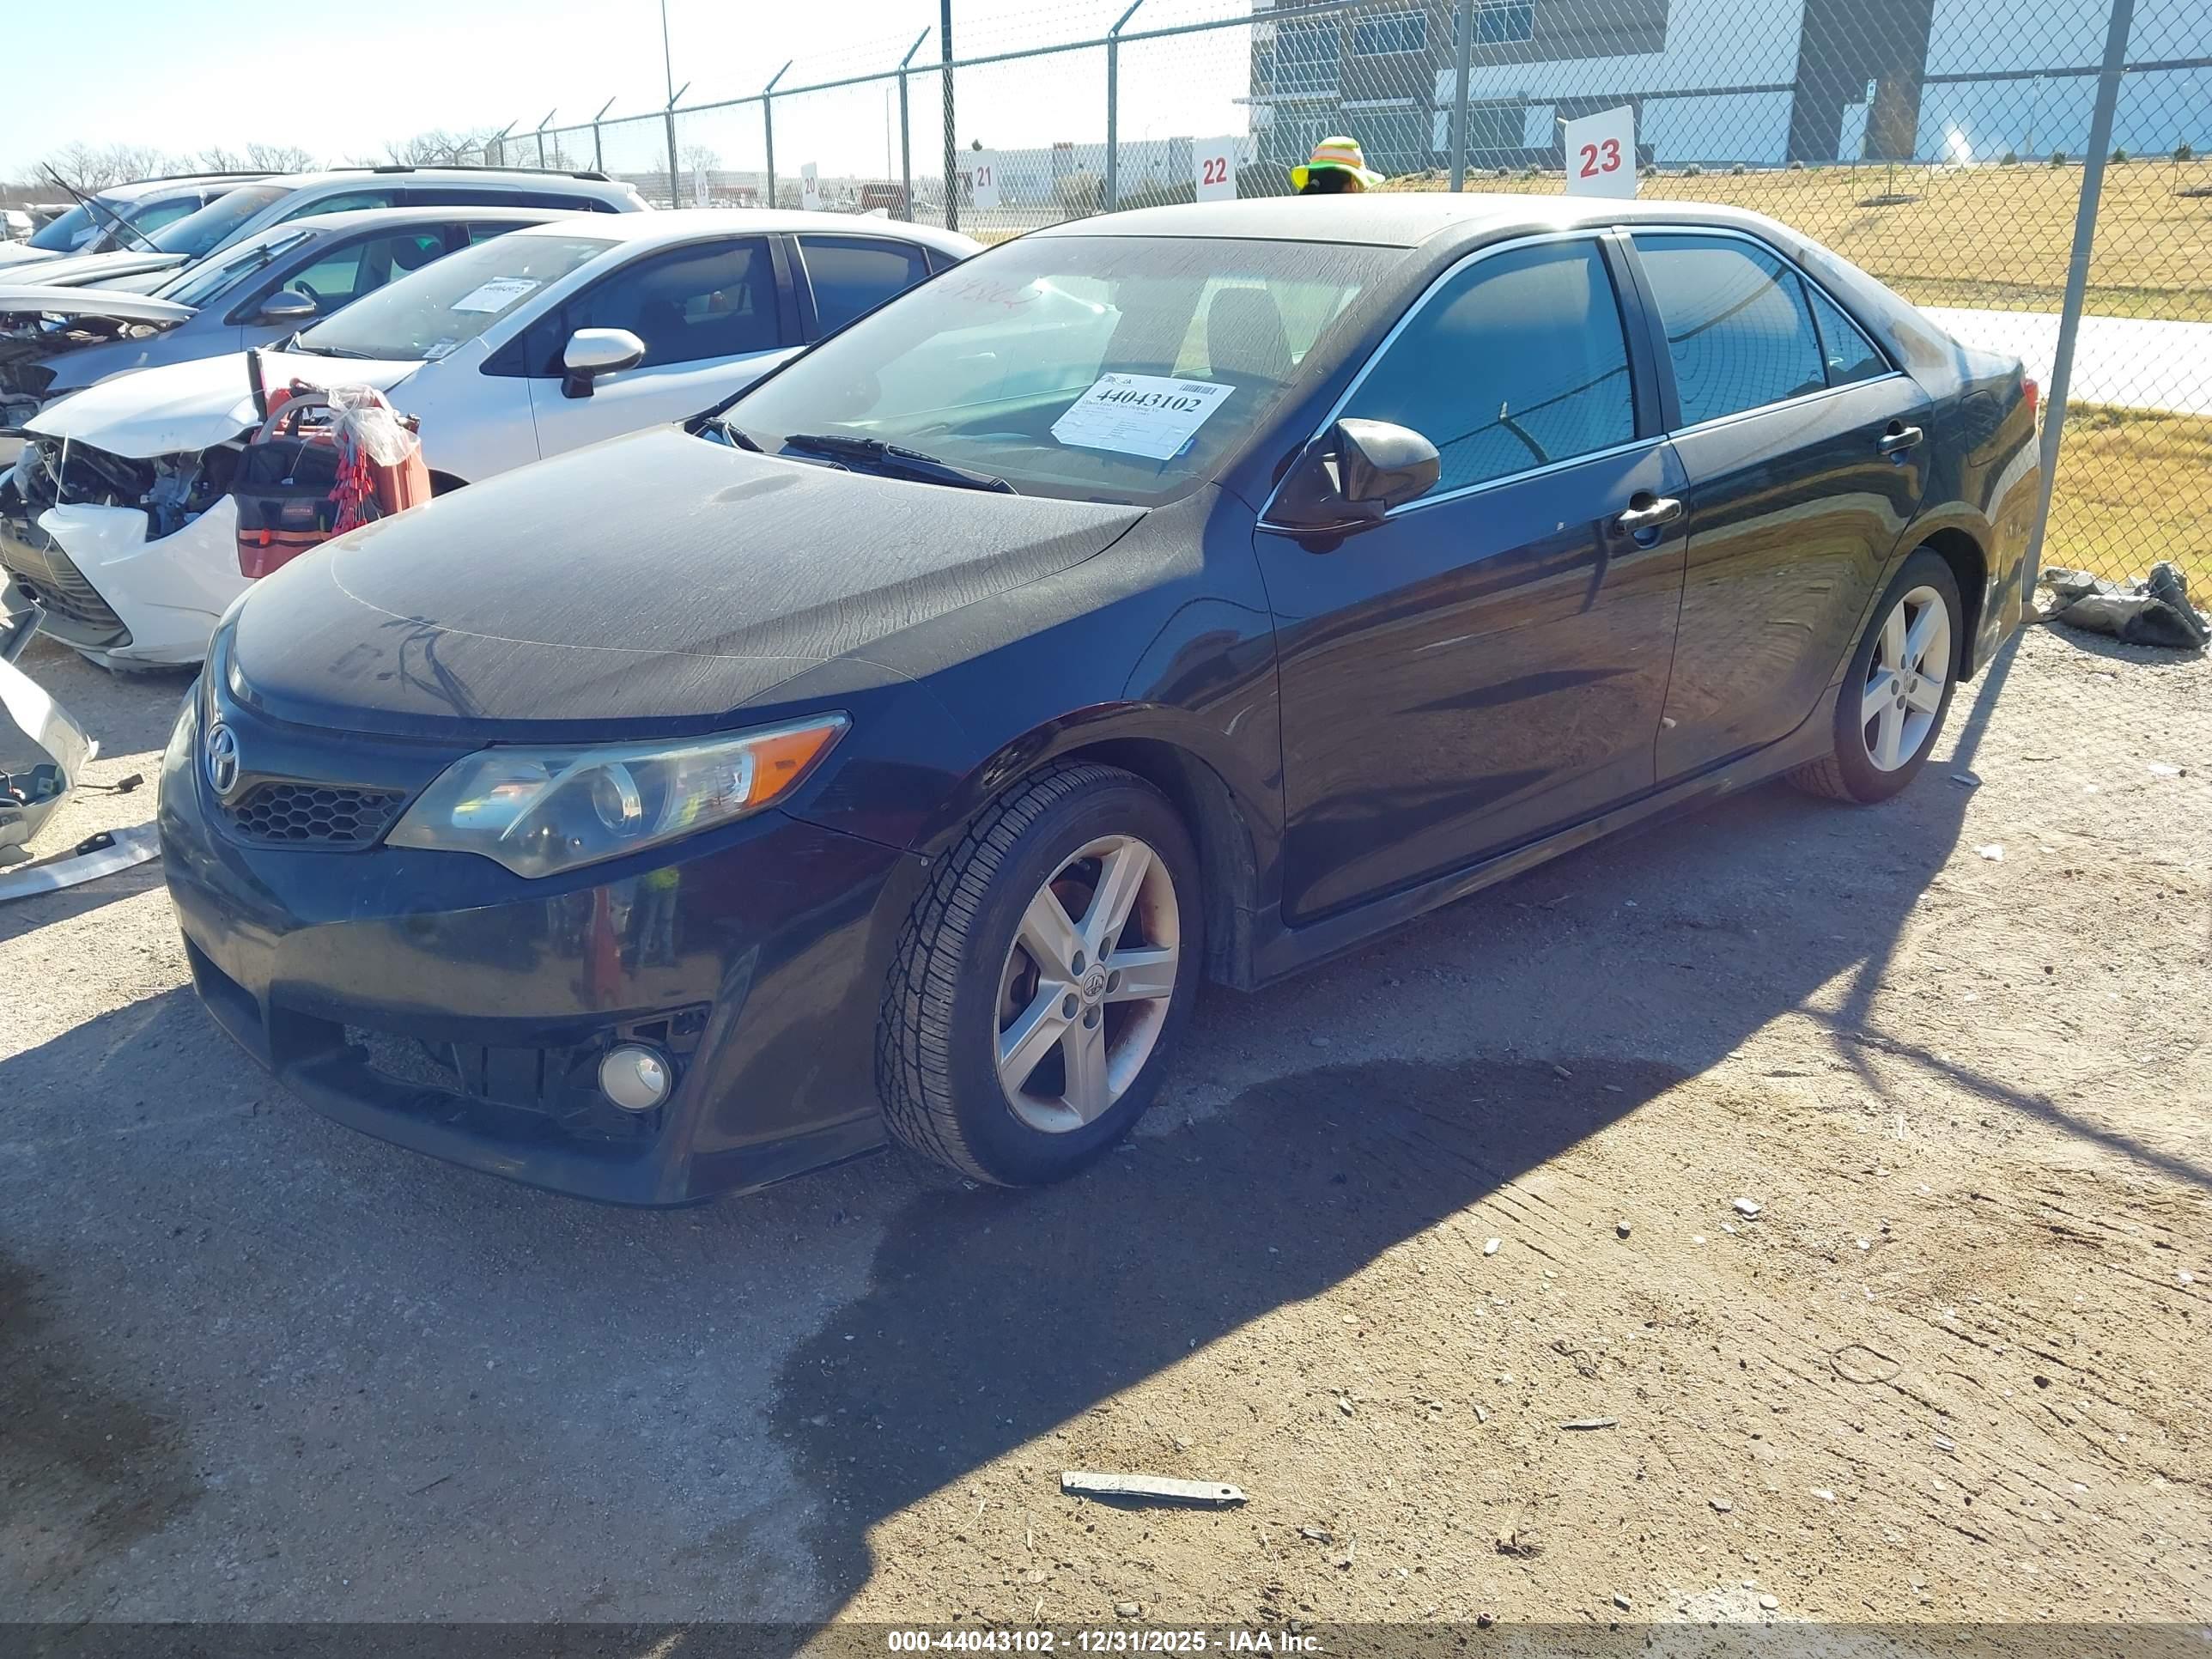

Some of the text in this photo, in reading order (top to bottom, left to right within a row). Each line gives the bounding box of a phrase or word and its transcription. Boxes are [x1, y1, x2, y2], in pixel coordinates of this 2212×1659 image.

[1580, 138, 1621, 179] 23
[977, 166, 991, 186] 21
[1203, 157, 1227, 185] 22
[805, 177, 815, 195] 20
[1097, 389, 1202, 413] 44043102
